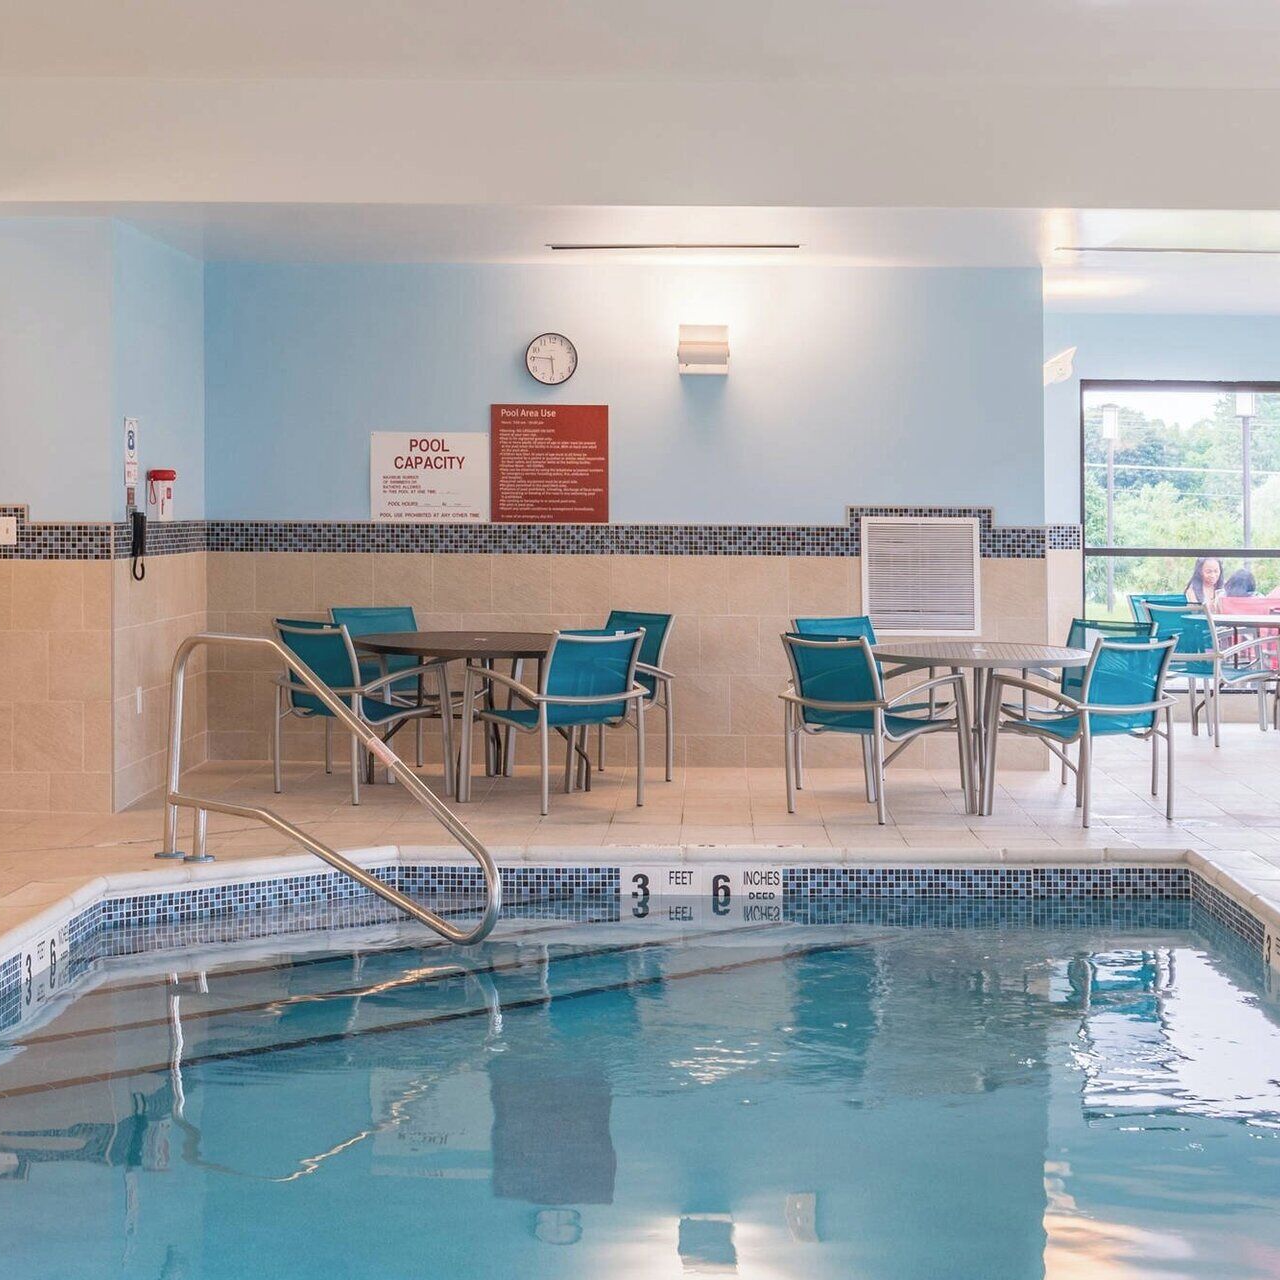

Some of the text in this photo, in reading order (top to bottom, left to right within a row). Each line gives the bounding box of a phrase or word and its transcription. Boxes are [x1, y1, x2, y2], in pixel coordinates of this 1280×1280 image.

[501, 408, 557, 418] Pool Area Use
[409, 438, 450, 452] POOL
[394, 456, 465, 469] CAPACITY
[631, 870, 780, 897] 3 FEET 6 INCHES
[1265, 934, 1272, 965] 3
[25, 953, 32, 982] 3
[49, 938, 57, 966] 6
